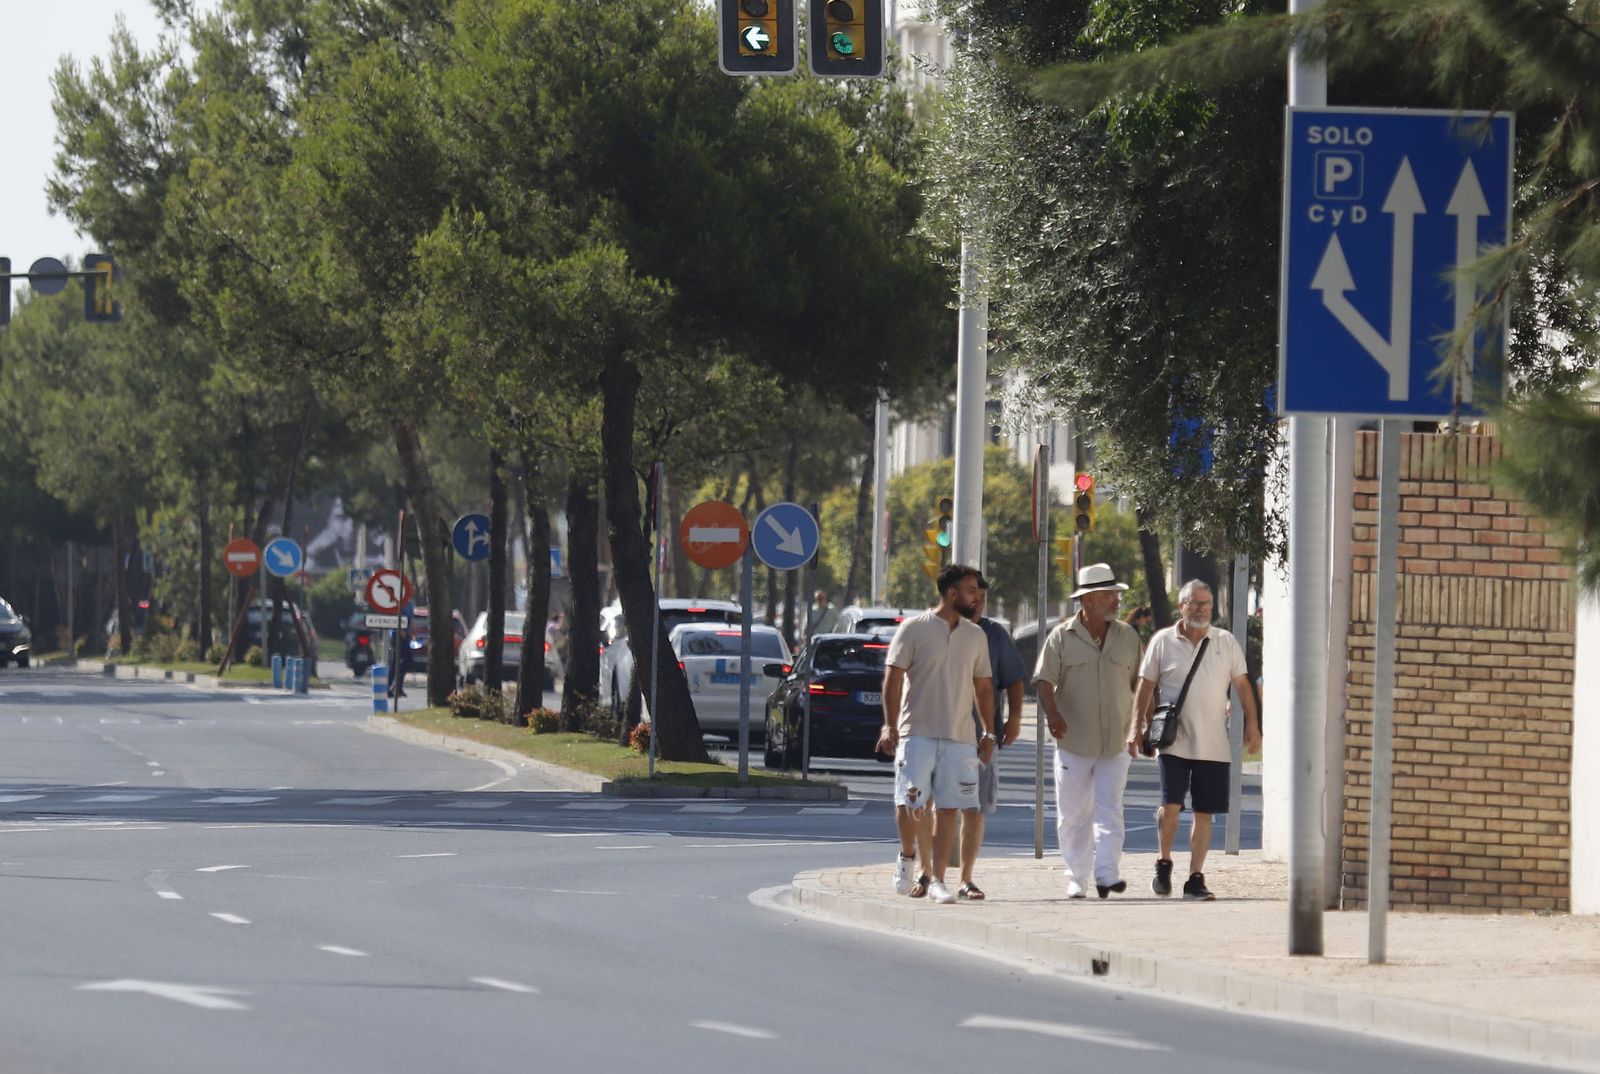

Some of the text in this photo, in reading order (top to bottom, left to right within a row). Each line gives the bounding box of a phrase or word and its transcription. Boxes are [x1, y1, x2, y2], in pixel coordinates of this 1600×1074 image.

[1307, 125, 1374, 146] SOLO
[1324, 156, 1353, 193] P
[1308, 204, 1368, 226] C y D
